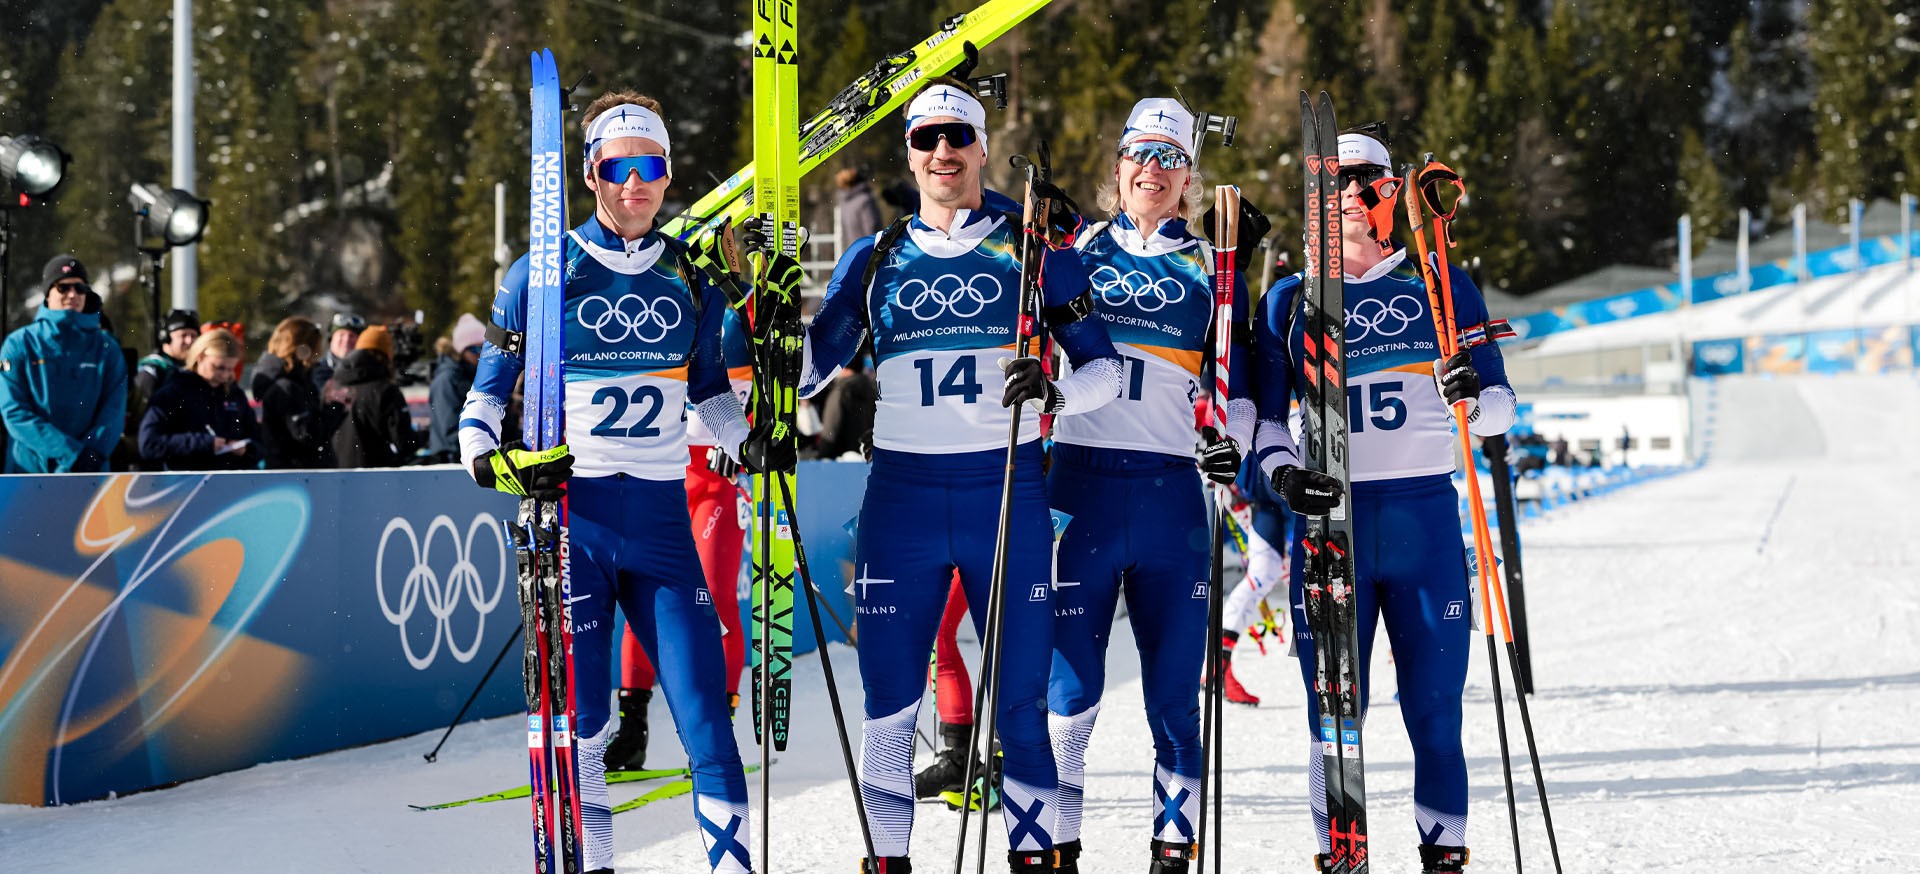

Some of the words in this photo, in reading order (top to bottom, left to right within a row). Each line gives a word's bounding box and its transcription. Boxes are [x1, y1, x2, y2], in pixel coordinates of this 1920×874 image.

[928, 106, 968, 118] FINLAND
[608, 125, 651, 134] FINLAND
[818, 114, 876, 160] FISCHER
[1144, 123, 1179, 136] FINLAND
[530, 154, 546, 288] SALOMON
[545, 151, 560, 287] SALOMON
[1327, 189, 1341, 279] ROSSIGNOL
[892, 328, 933, 343] MILANO
[933, 325, 984, 337] CORTINA
[986, 325, 1009, 335] 2026
[1118, 313, 1160, 331] CORTINA
[1161, 324, 1183, 337] 2026
[571, 351, 617, 362] MILANO
[619, 351, 665, 361] CORTINA
[667, 353, 683, 361] 2026
[1361, 343, 1410, 355] CORTINA
[1413, 341, 1434, 350] 2026
[914, 355, 983, 407] 14
[590, 385, 664, 438] 22
[1347, 381, 1408, 433] 15
[702, 505, 723, 540] odlo
[560, 525, 573, 634] SALOMON
[1054, 607, 1085, 617] LAND
[530, 719, 540, 729] 22
[556, 719, 566, 729] 22
[774, 687, 787, 742] SPEED
[1324, 731, 1333, 739] 15
[1346, 733, 1355, 742] 15
